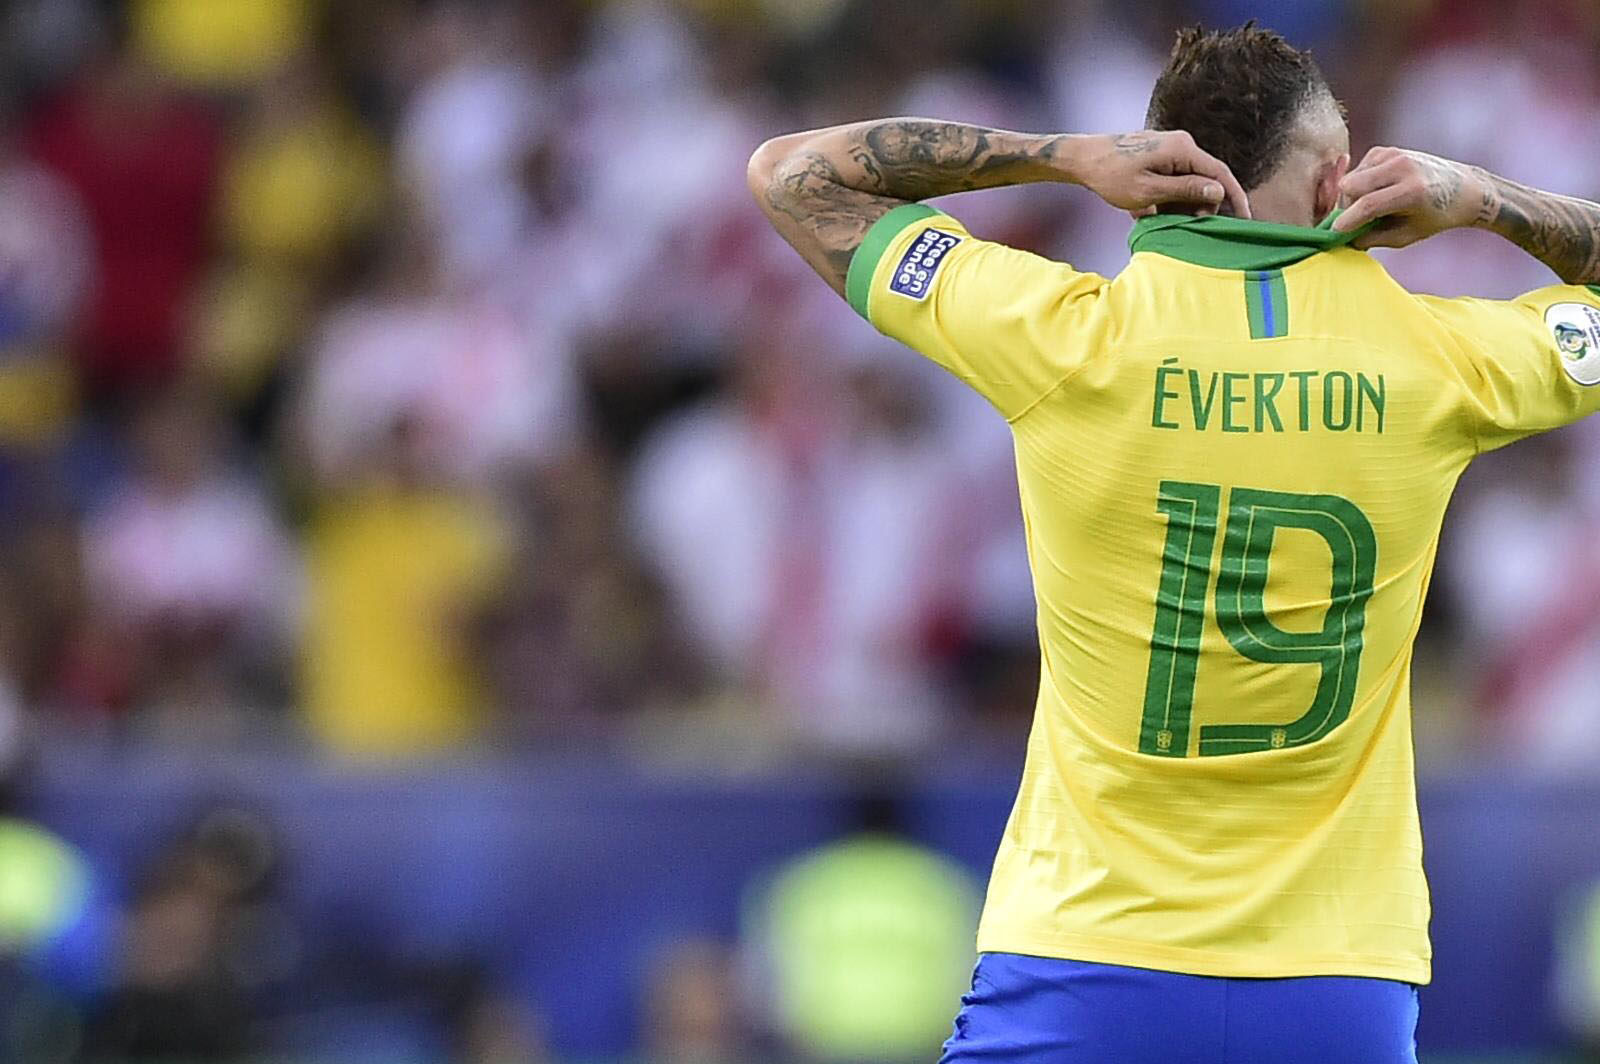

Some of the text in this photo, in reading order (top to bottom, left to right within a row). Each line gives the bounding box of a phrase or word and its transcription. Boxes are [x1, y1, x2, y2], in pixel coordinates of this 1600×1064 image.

[899, 230, 941, 285] grande
[910, 237, 956, 293] Cree en
[1152, 357, 1386, 434] ÉVERTON
[1138, 480, 1378, 758] 19
